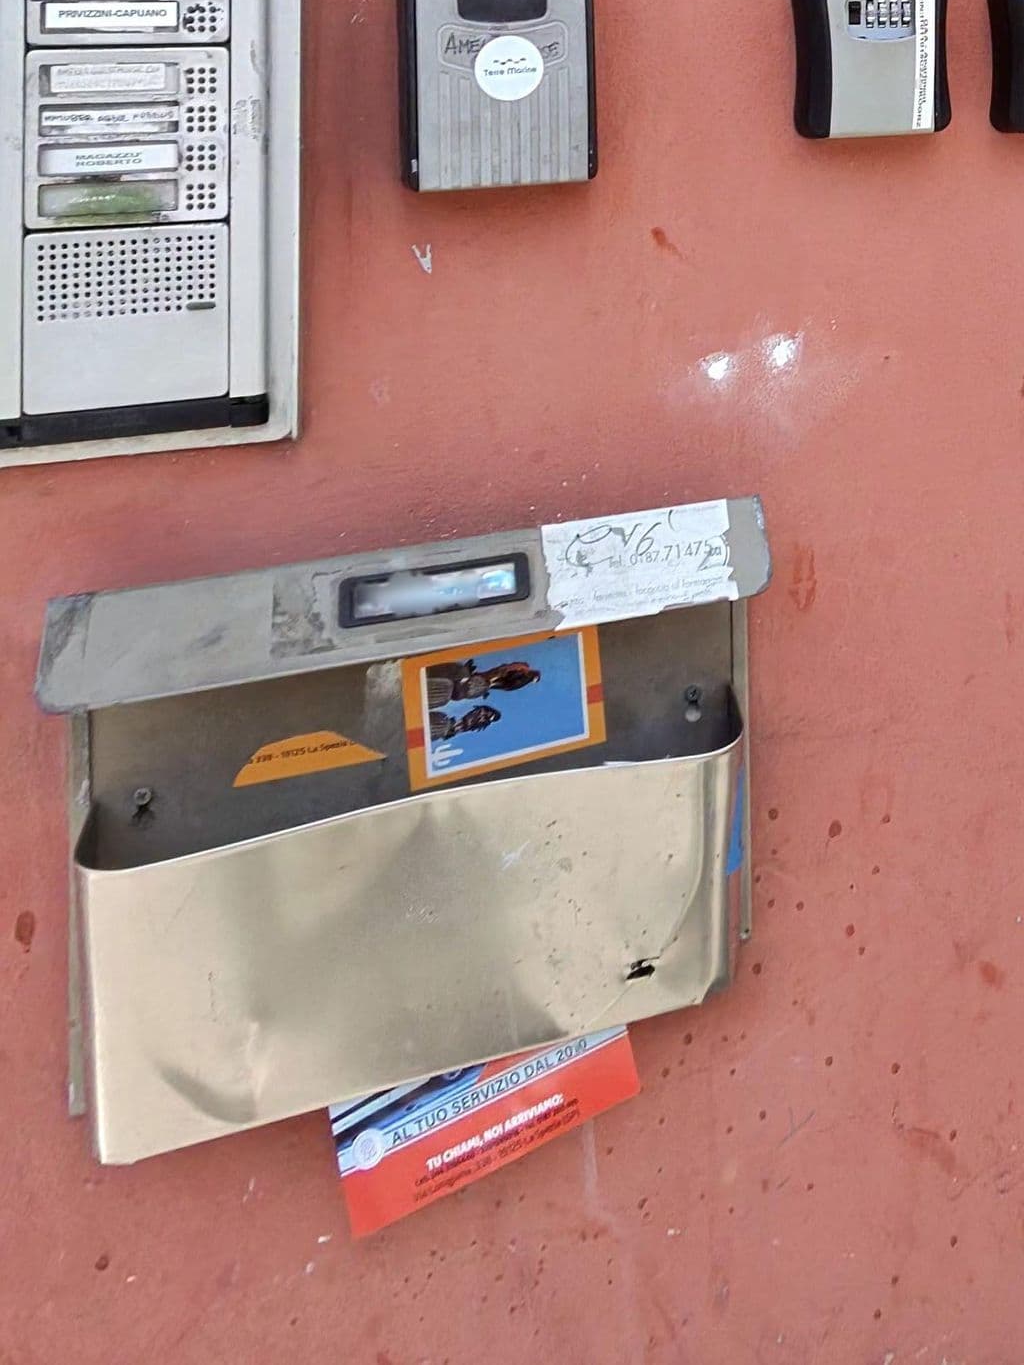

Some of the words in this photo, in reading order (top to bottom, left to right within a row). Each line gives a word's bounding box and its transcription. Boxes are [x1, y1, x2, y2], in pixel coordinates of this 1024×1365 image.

[392, 1126, 412, 1145] AL
[414, 1107, 448, 1131] TUO
[452, 1071, 521, 1115] SERVIZIO
[523, 1056, 554, 1078] DAL
[426, 1155, 441, 1172] TU
[482, 1123, 504, 1142] NOI
